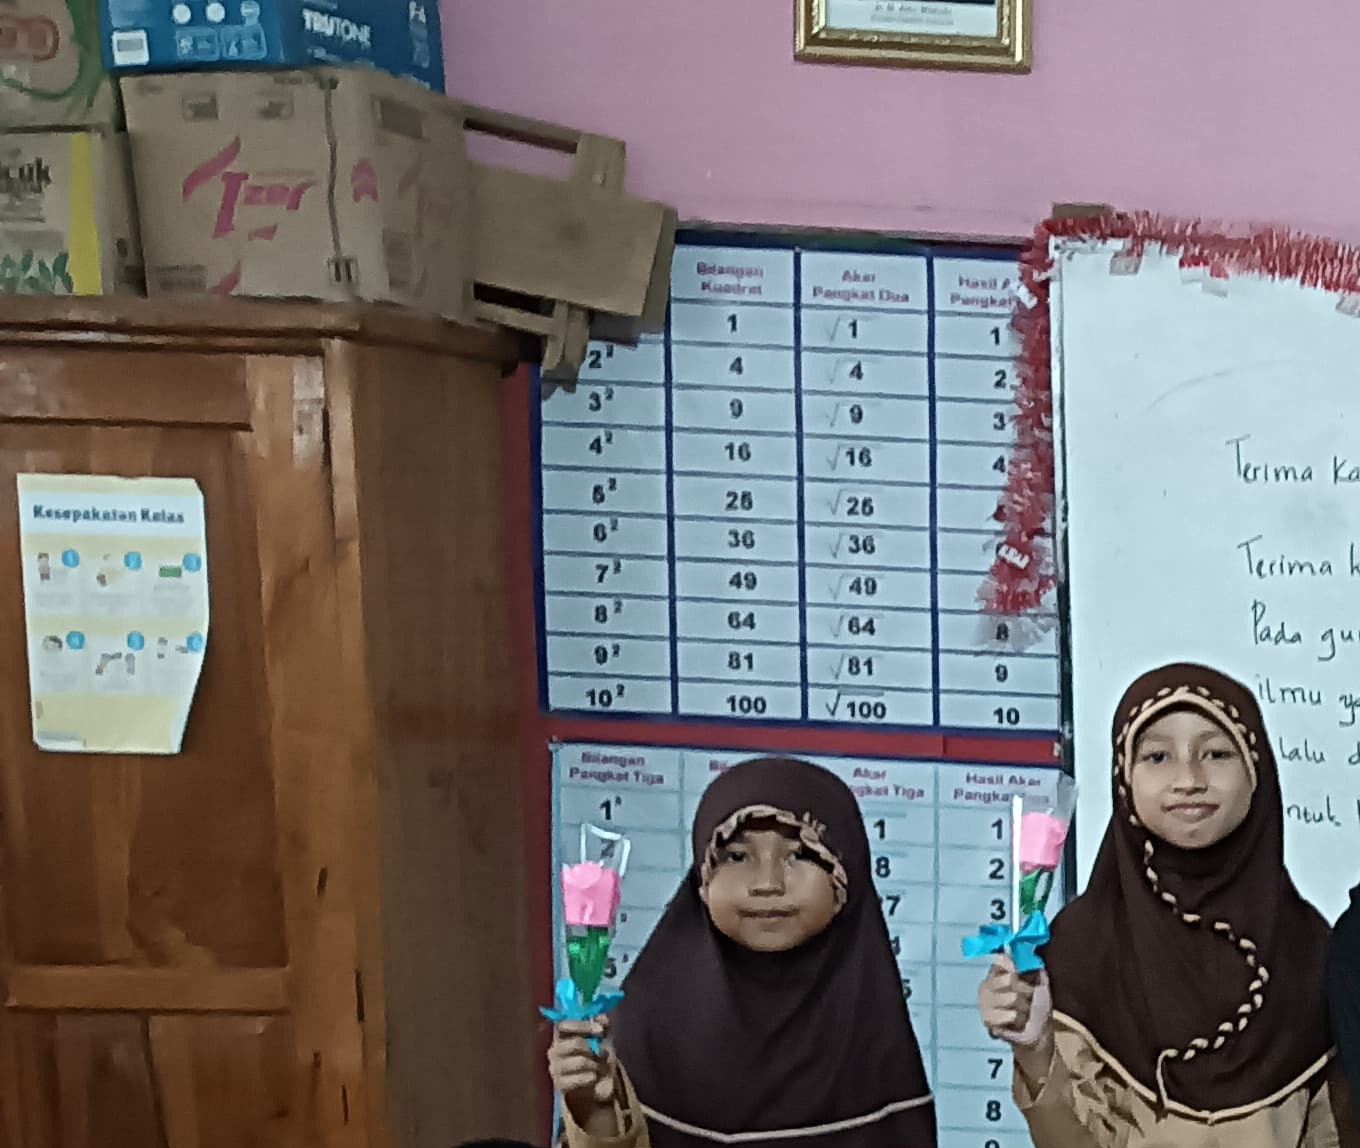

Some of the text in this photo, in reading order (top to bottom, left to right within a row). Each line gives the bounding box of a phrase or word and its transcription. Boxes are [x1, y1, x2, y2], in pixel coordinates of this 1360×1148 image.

[729, 356, 743, 375] 4
[729, 398, 744, 419] 9
[724, 442, 752, 462] 16
[1226, 434, 1314, 482] Terima
[726, 490, 753, 511] 25
[33, 505, 185, 525] Kesepakatan Kelas
[728, 529, 755, 550] 36
[1236, 535, 1334, 579] Terima
[728, 571, 758, 591] 49
[727, 611, 756, 630] 64
[1251, 600, 1303, 646] Pada
[727, 651, 754, 671] 81
[725, 695, 767, 715] 100
[1278, 735, 1325, 763] lalu
[991, 818, 1004, 840] 1
[988, 858, 1005, 880] 2
[990, 899, 1006, 921] 3
[987, 1058, 1003, 1079] 7
[985, 1100, 1002, 1122] 8
